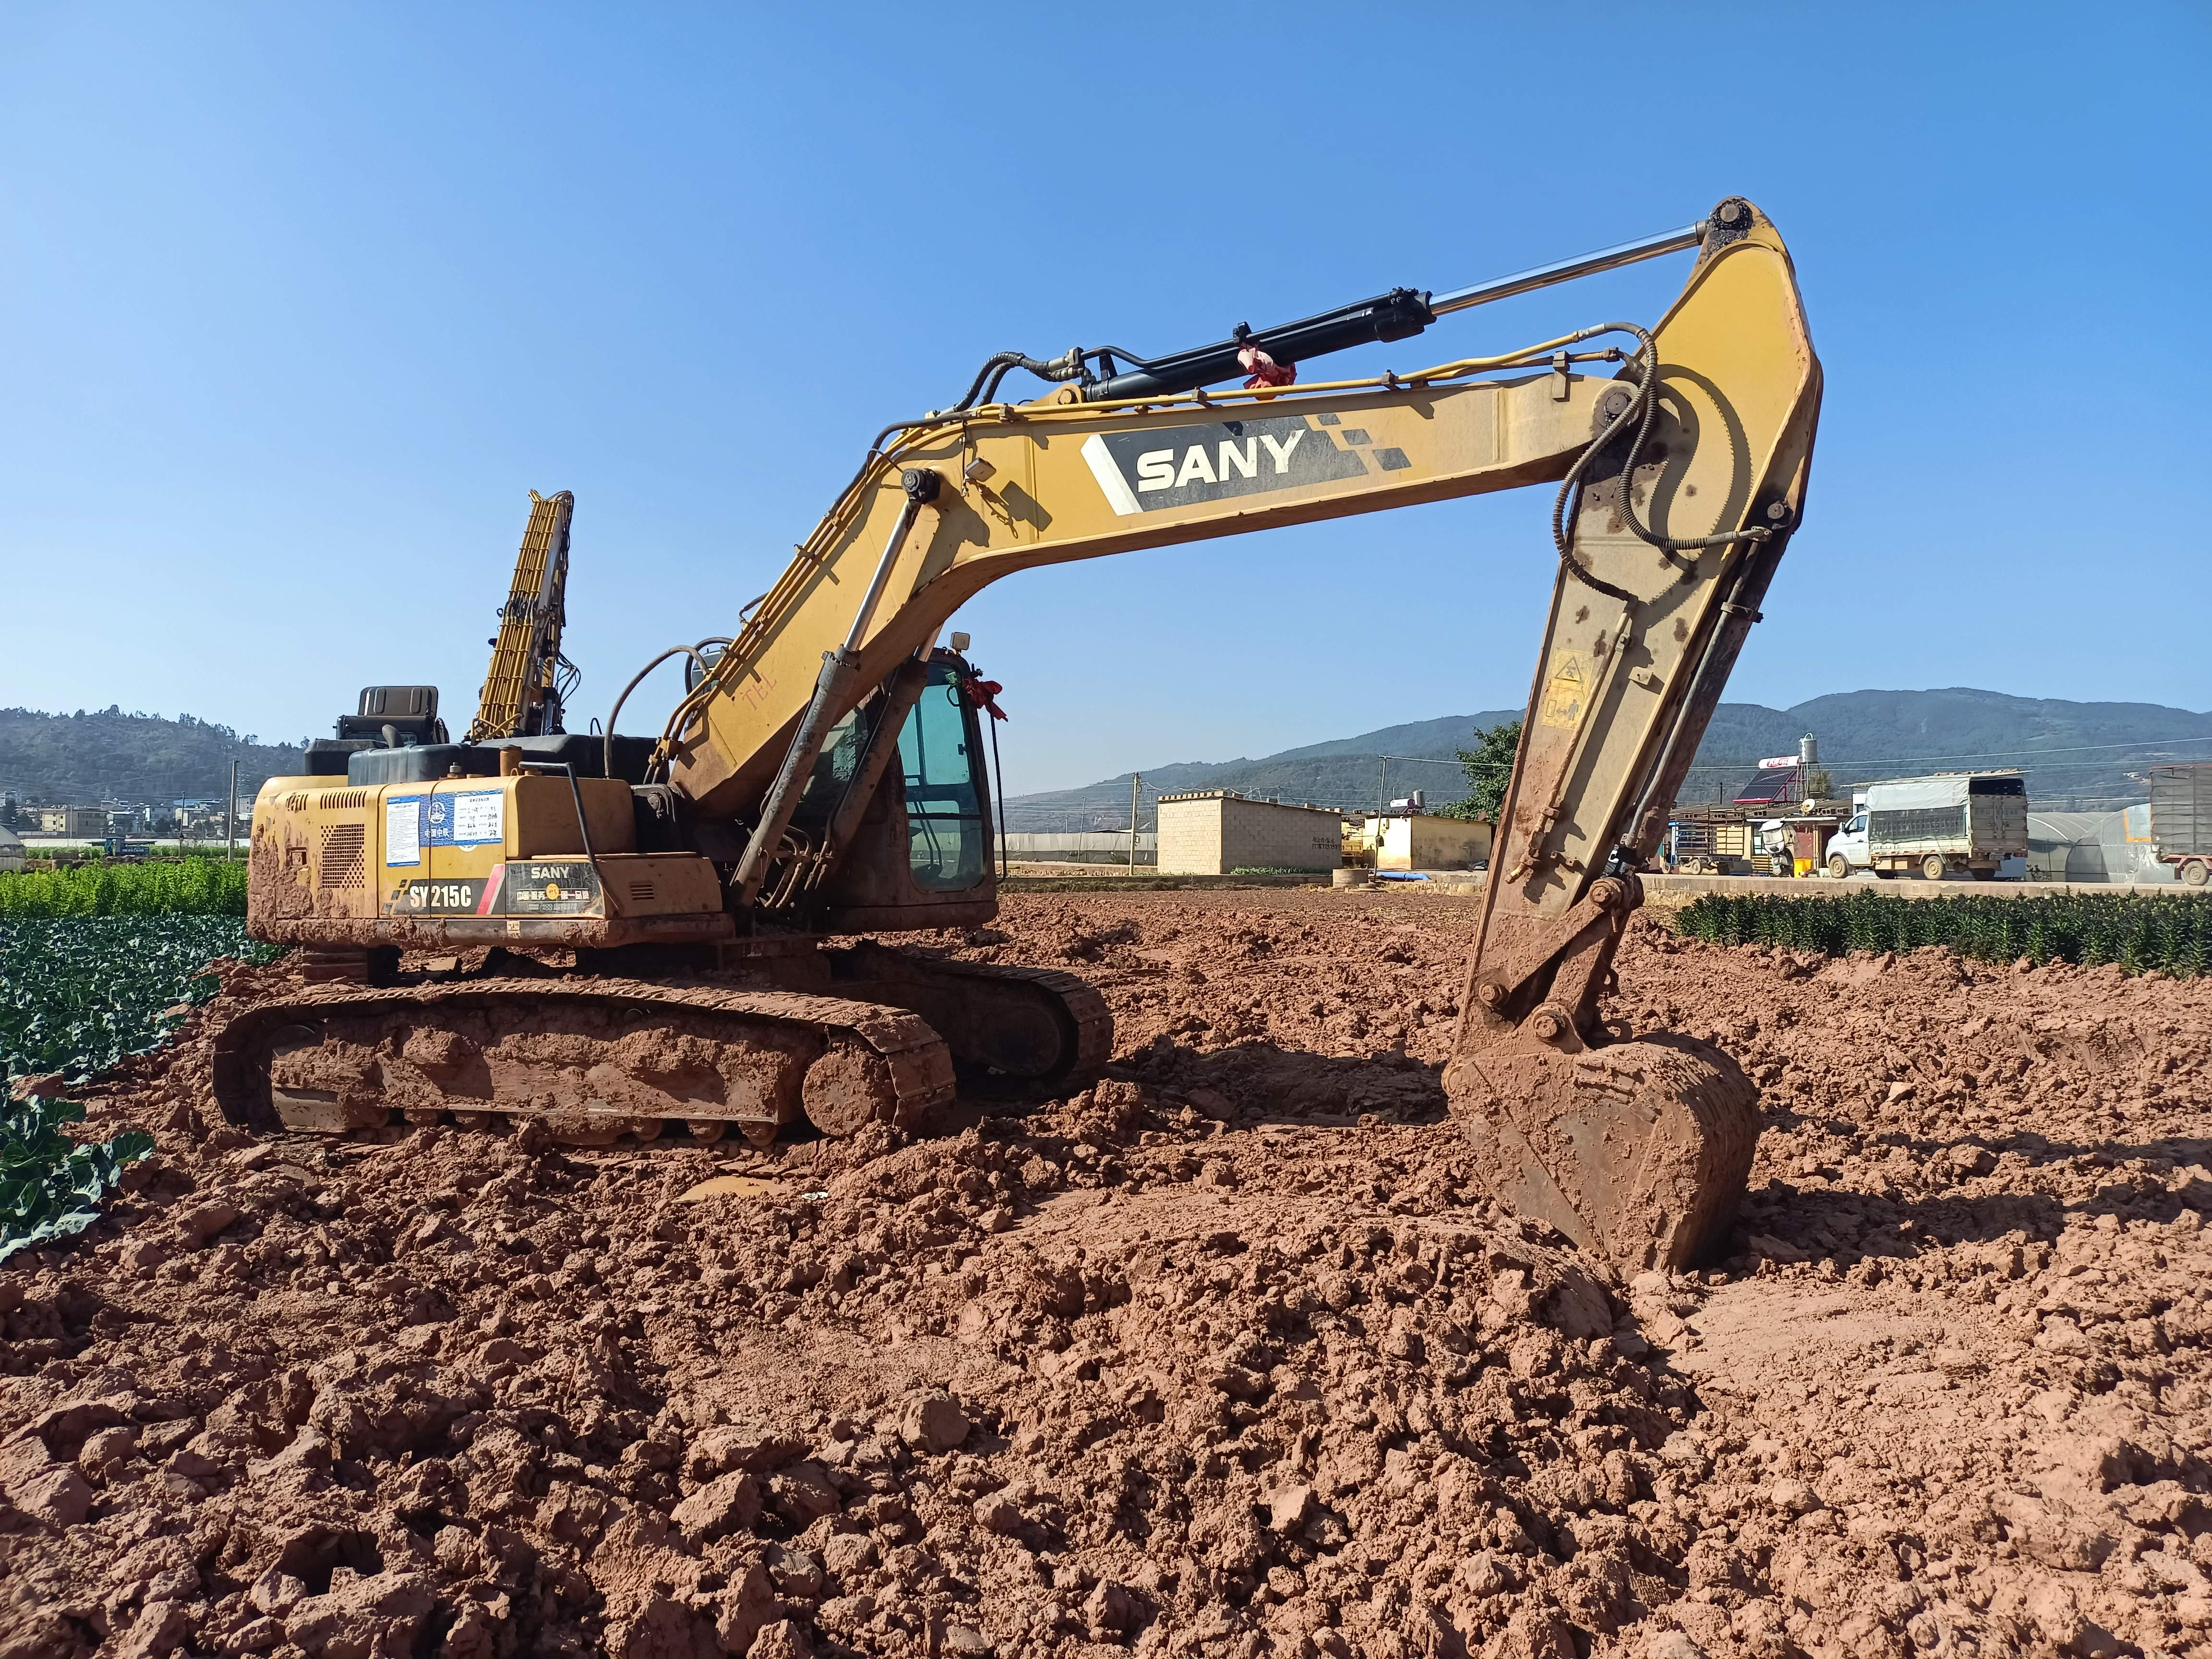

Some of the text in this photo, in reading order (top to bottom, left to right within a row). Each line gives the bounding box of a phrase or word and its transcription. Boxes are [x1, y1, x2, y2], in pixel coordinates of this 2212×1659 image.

[1137, 429, 1306, 493] SANY
[742, 672, 777, 710] TEL
[531, 866, 569, 879] SANY
